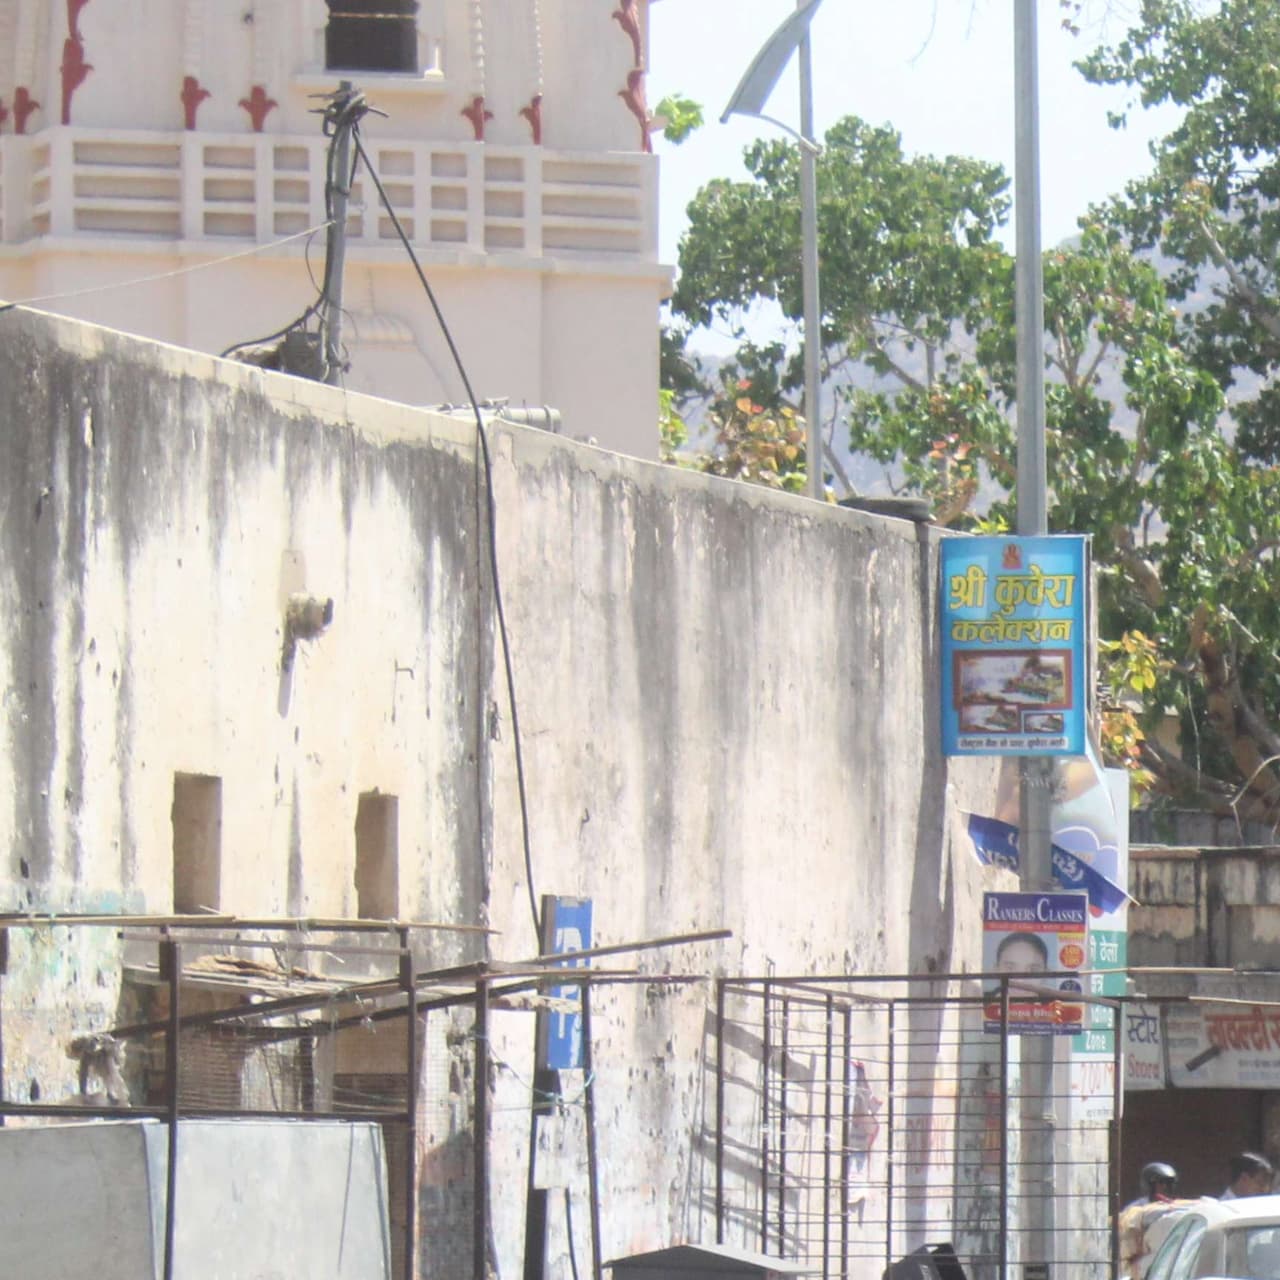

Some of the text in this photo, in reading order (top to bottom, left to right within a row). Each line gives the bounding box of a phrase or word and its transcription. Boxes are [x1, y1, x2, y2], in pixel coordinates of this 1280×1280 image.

[949, 564, 988, 610] श्री
[951, 611, 1073, 643] कलेक्शन
[1127, 1004, 1160, 1045] स्टोर
